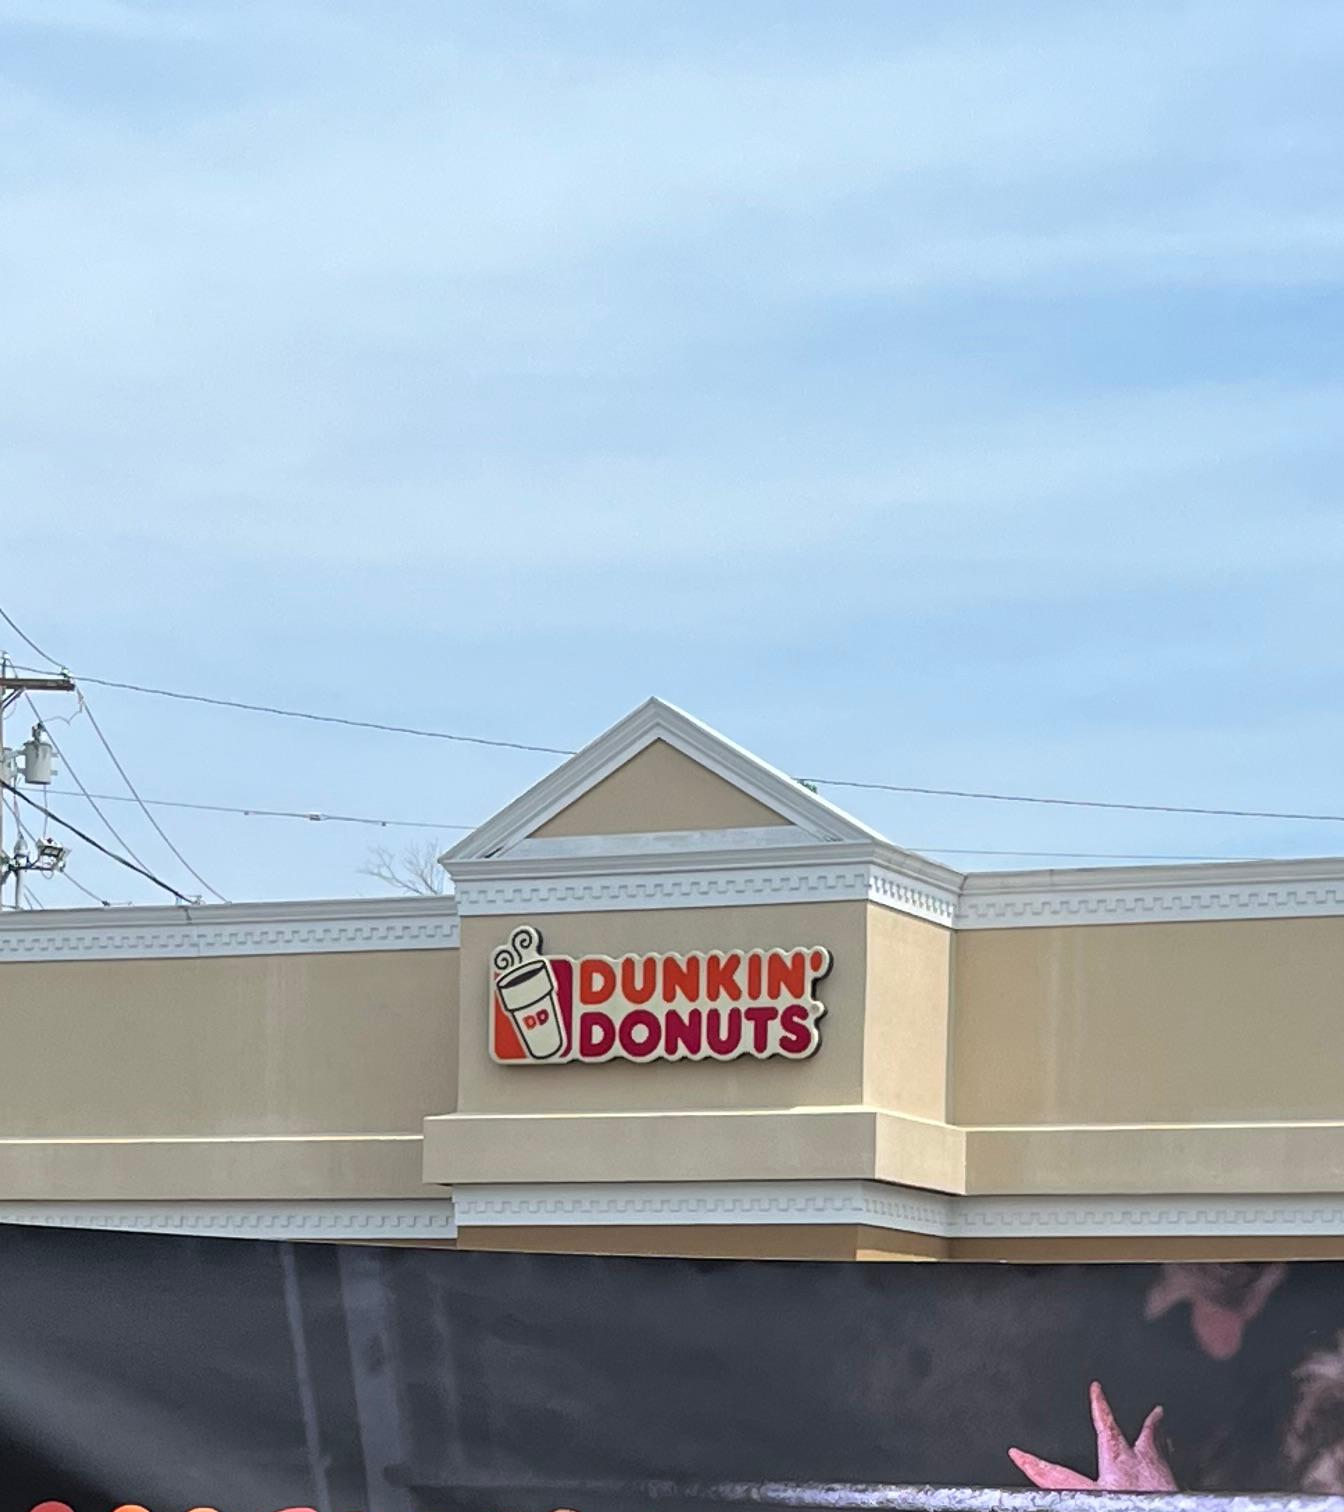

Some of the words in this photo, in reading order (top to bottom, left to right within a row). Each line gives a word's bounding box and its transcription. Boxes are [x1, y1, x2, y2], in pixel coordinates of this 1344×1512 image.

[579, 950, 823, 1006] DUNKIN'
[522, 1009, 550, 1030] DD
[578, 1004, 812, 1058] DONUTS
